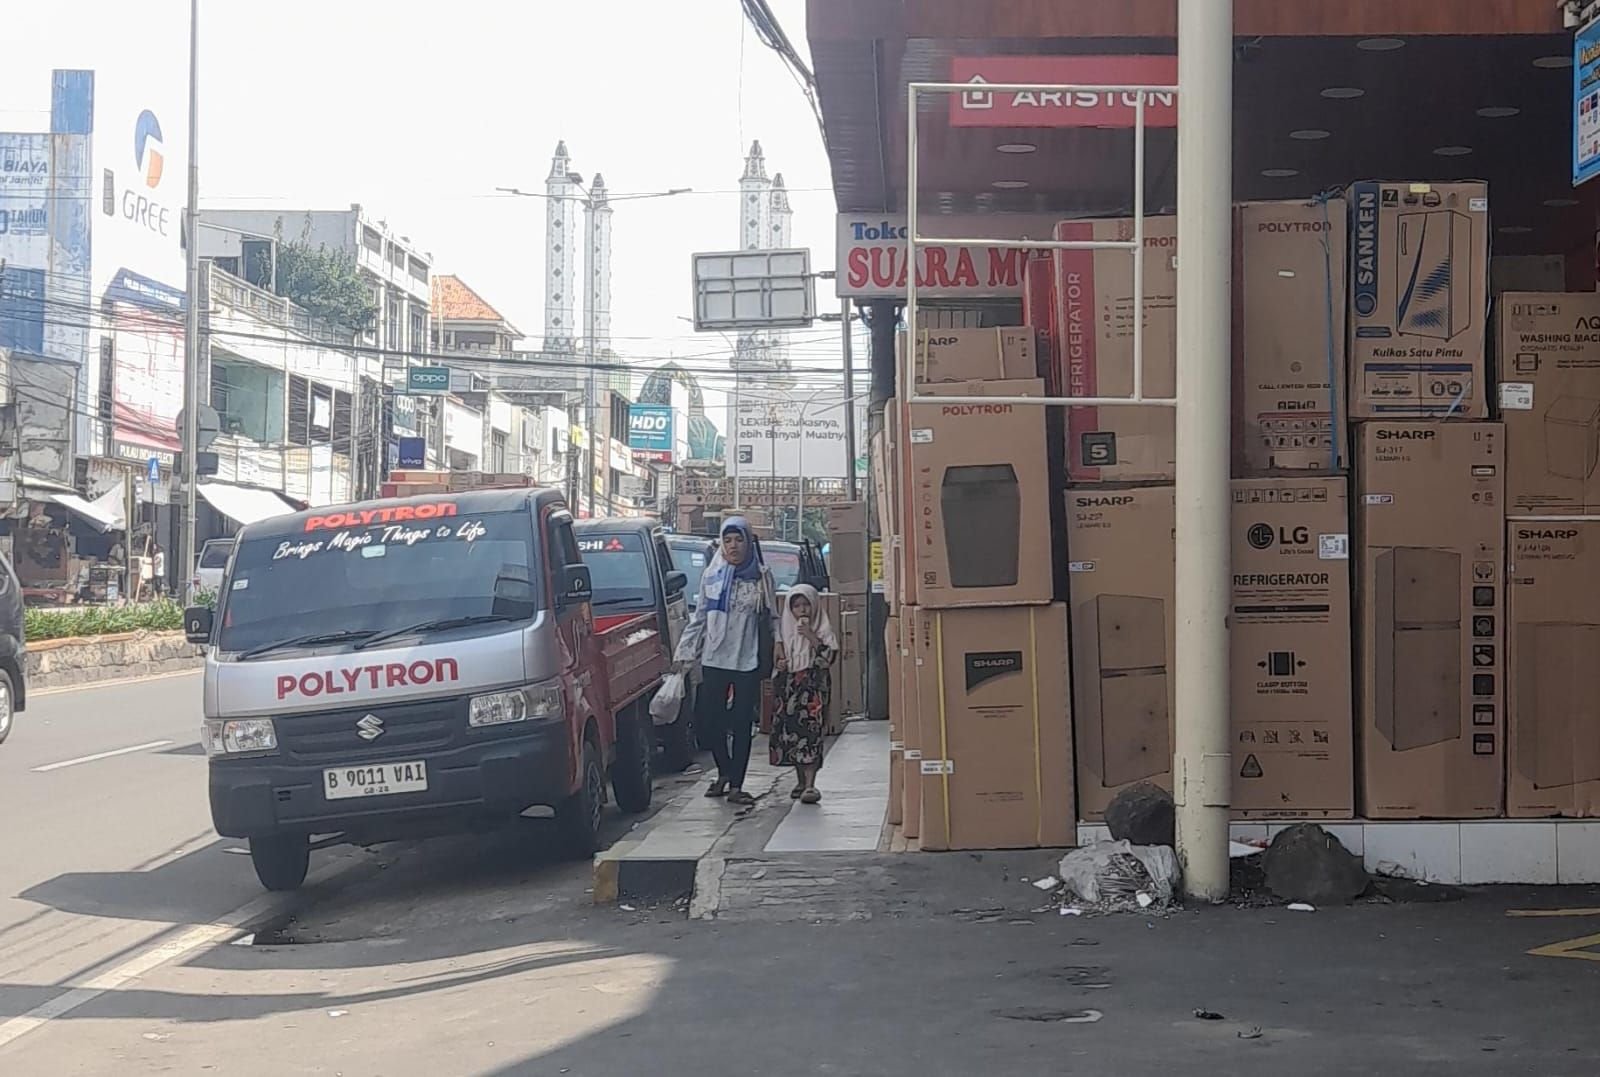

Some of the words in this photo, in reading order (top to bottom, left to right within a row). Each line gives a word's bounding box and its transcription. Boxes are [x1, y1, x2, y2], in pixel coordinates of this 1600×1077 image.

[3, 159, 48, 174] BIAYA
[122, 189, 169, 237] GREE
[1258, 221, 1332, 233] POLYTRON
[1358, 193, 1376, 286] SANKEN
[847, 246, 979, 288] SUARA
[917, 336, 959, 346] HARP
[1066, 271, 1086, 410] EFRIGERATOR
[1519, 334, 1571, 343] WASHING
[1372, 347, 1407, 358] Kulkas
[1409, 347, 1433, 358] Satu
[1435, 347, 1463, 358] Pintu
[412, 374, 447, 385] oppo
[942, 404, 1013, 416] POLYTRON
[805, 428, 848, 442] Muatny
[1375, 430, 1436, 440] SHARP
[1091, 444, 1108, 458] 5
[401, 457, 423, 465] vivo
[1076, 496, 1134, 507] SHARP
[304, 501, 458, 533] POLYTRON
[272, 540, 328, 560] Brings
[326, 529, 373, 553] Magic
[382, 524, 432, 546] Things
[435, 525, 452, 538] to
[455, 519, 488, 543] Life
[1279, 526, 1309, 545] LG
[1518, 529, 1578, 539] SHARP
[1233, 573, 1329, 586] REFRIGERATOR
[973, 660, 1014, 668] SHARP
[276, 657, 459, 700] POLYTRON
[327, 771, 339, 789] B
[345, 766, 387, 787] 9011
